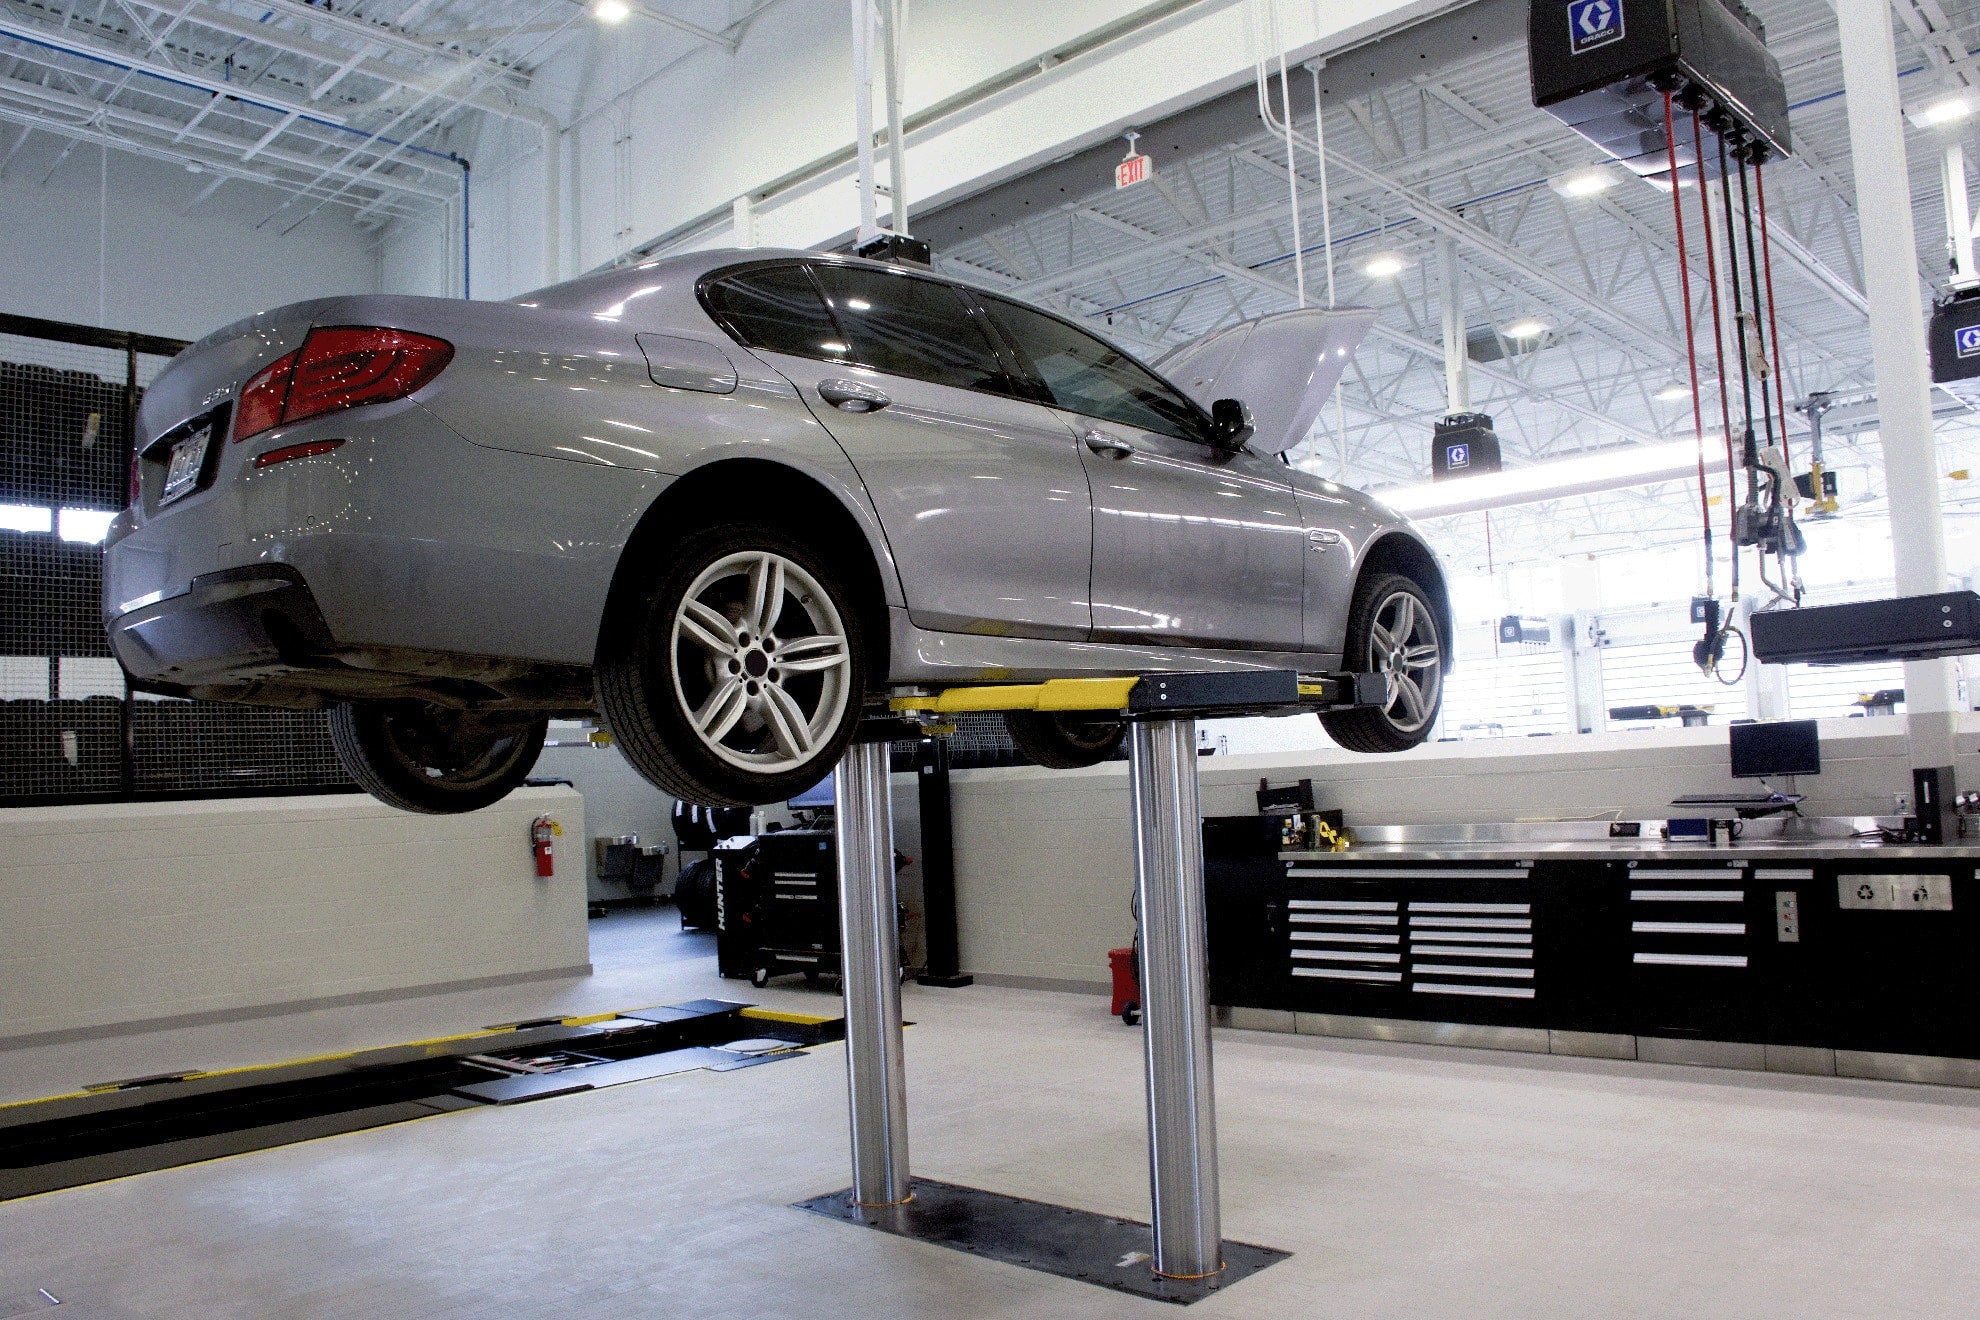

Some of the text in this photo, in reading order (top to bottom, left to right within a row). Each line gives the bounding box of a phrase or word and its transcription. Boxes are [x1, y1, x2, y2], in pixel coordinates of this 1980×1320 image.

[1580, 28, 1614, 44] GRACO
[1120, 158, 1144, 187] EXIT
[715, 858, 726, 931] HUNTER
